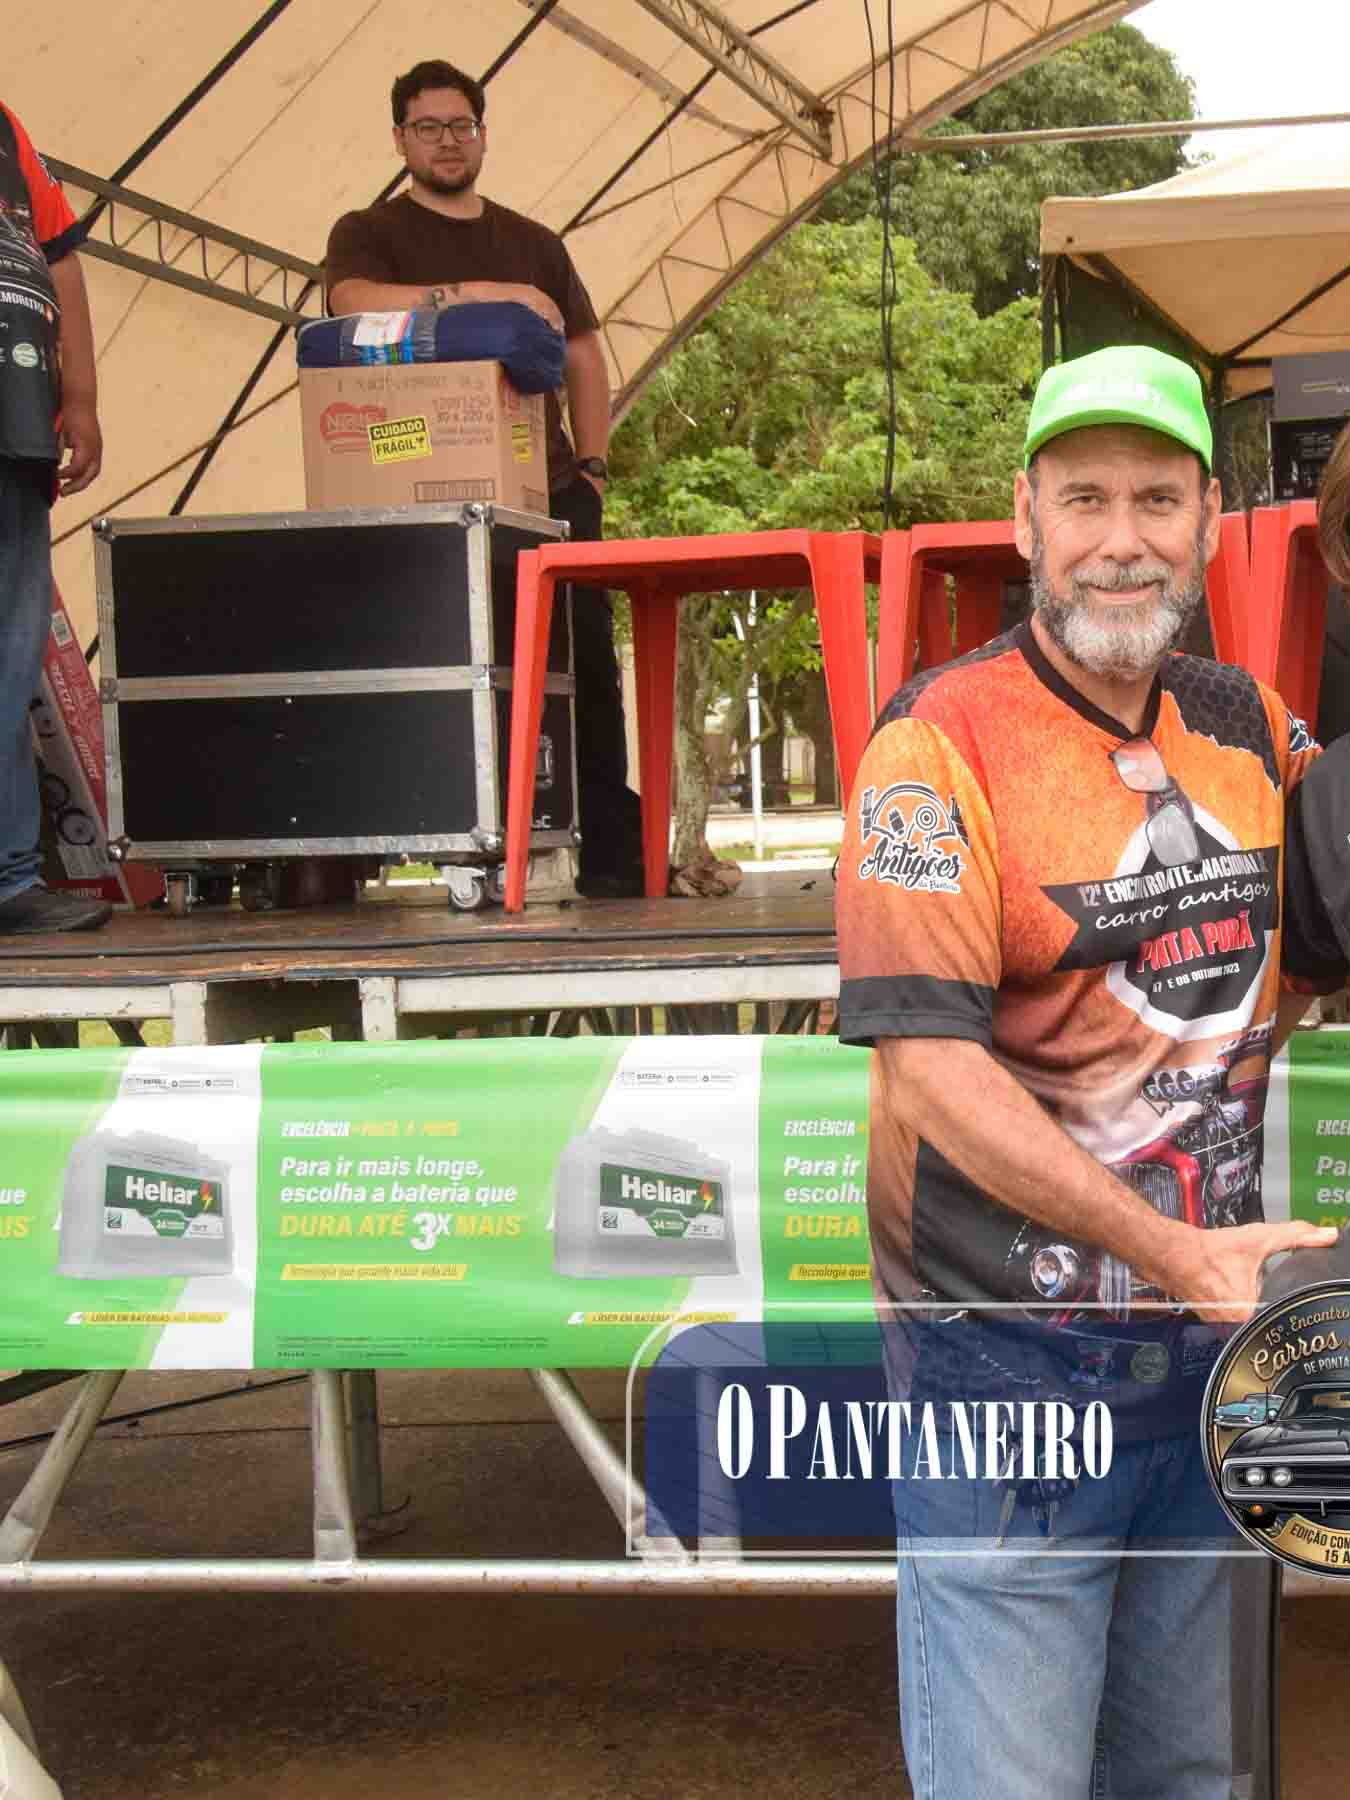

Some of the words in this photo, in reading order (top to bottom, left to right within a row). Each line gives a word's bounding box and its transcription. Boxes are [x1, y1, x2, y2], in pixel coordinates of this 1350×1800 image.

[373, 420, 423, 439] CUIDADO
[376, 437, 416, 456] FRÁGIL
[860, 838, 960, 888] Antigões
[281, 1156, 331, 1176] Para
[336, 1155, 352, 1176] ir
[358, 1155, 410, 1176] mais
[416, 1155, 484, 1180] longe,
[784, 1155, 836, 1177] Para
[842, 1154, 861, 1177] ir
[0, 1187, 27, 1205] ue
[126, 1176, 197, 1205] Heliar
[281, 1183, 367, 1203] escolha
[371, 1187, 385, 1203] a
[391, 1181, 470, 1203] bateria
[476, 1186, 517, 1207] que
[622, 1174, 696, 1205] Heliar
[280, 1215, 352, 1238] DURA
[357, 1207, 408, 1238] ATÉ
[784, 1215, 861, 1239] DURA
